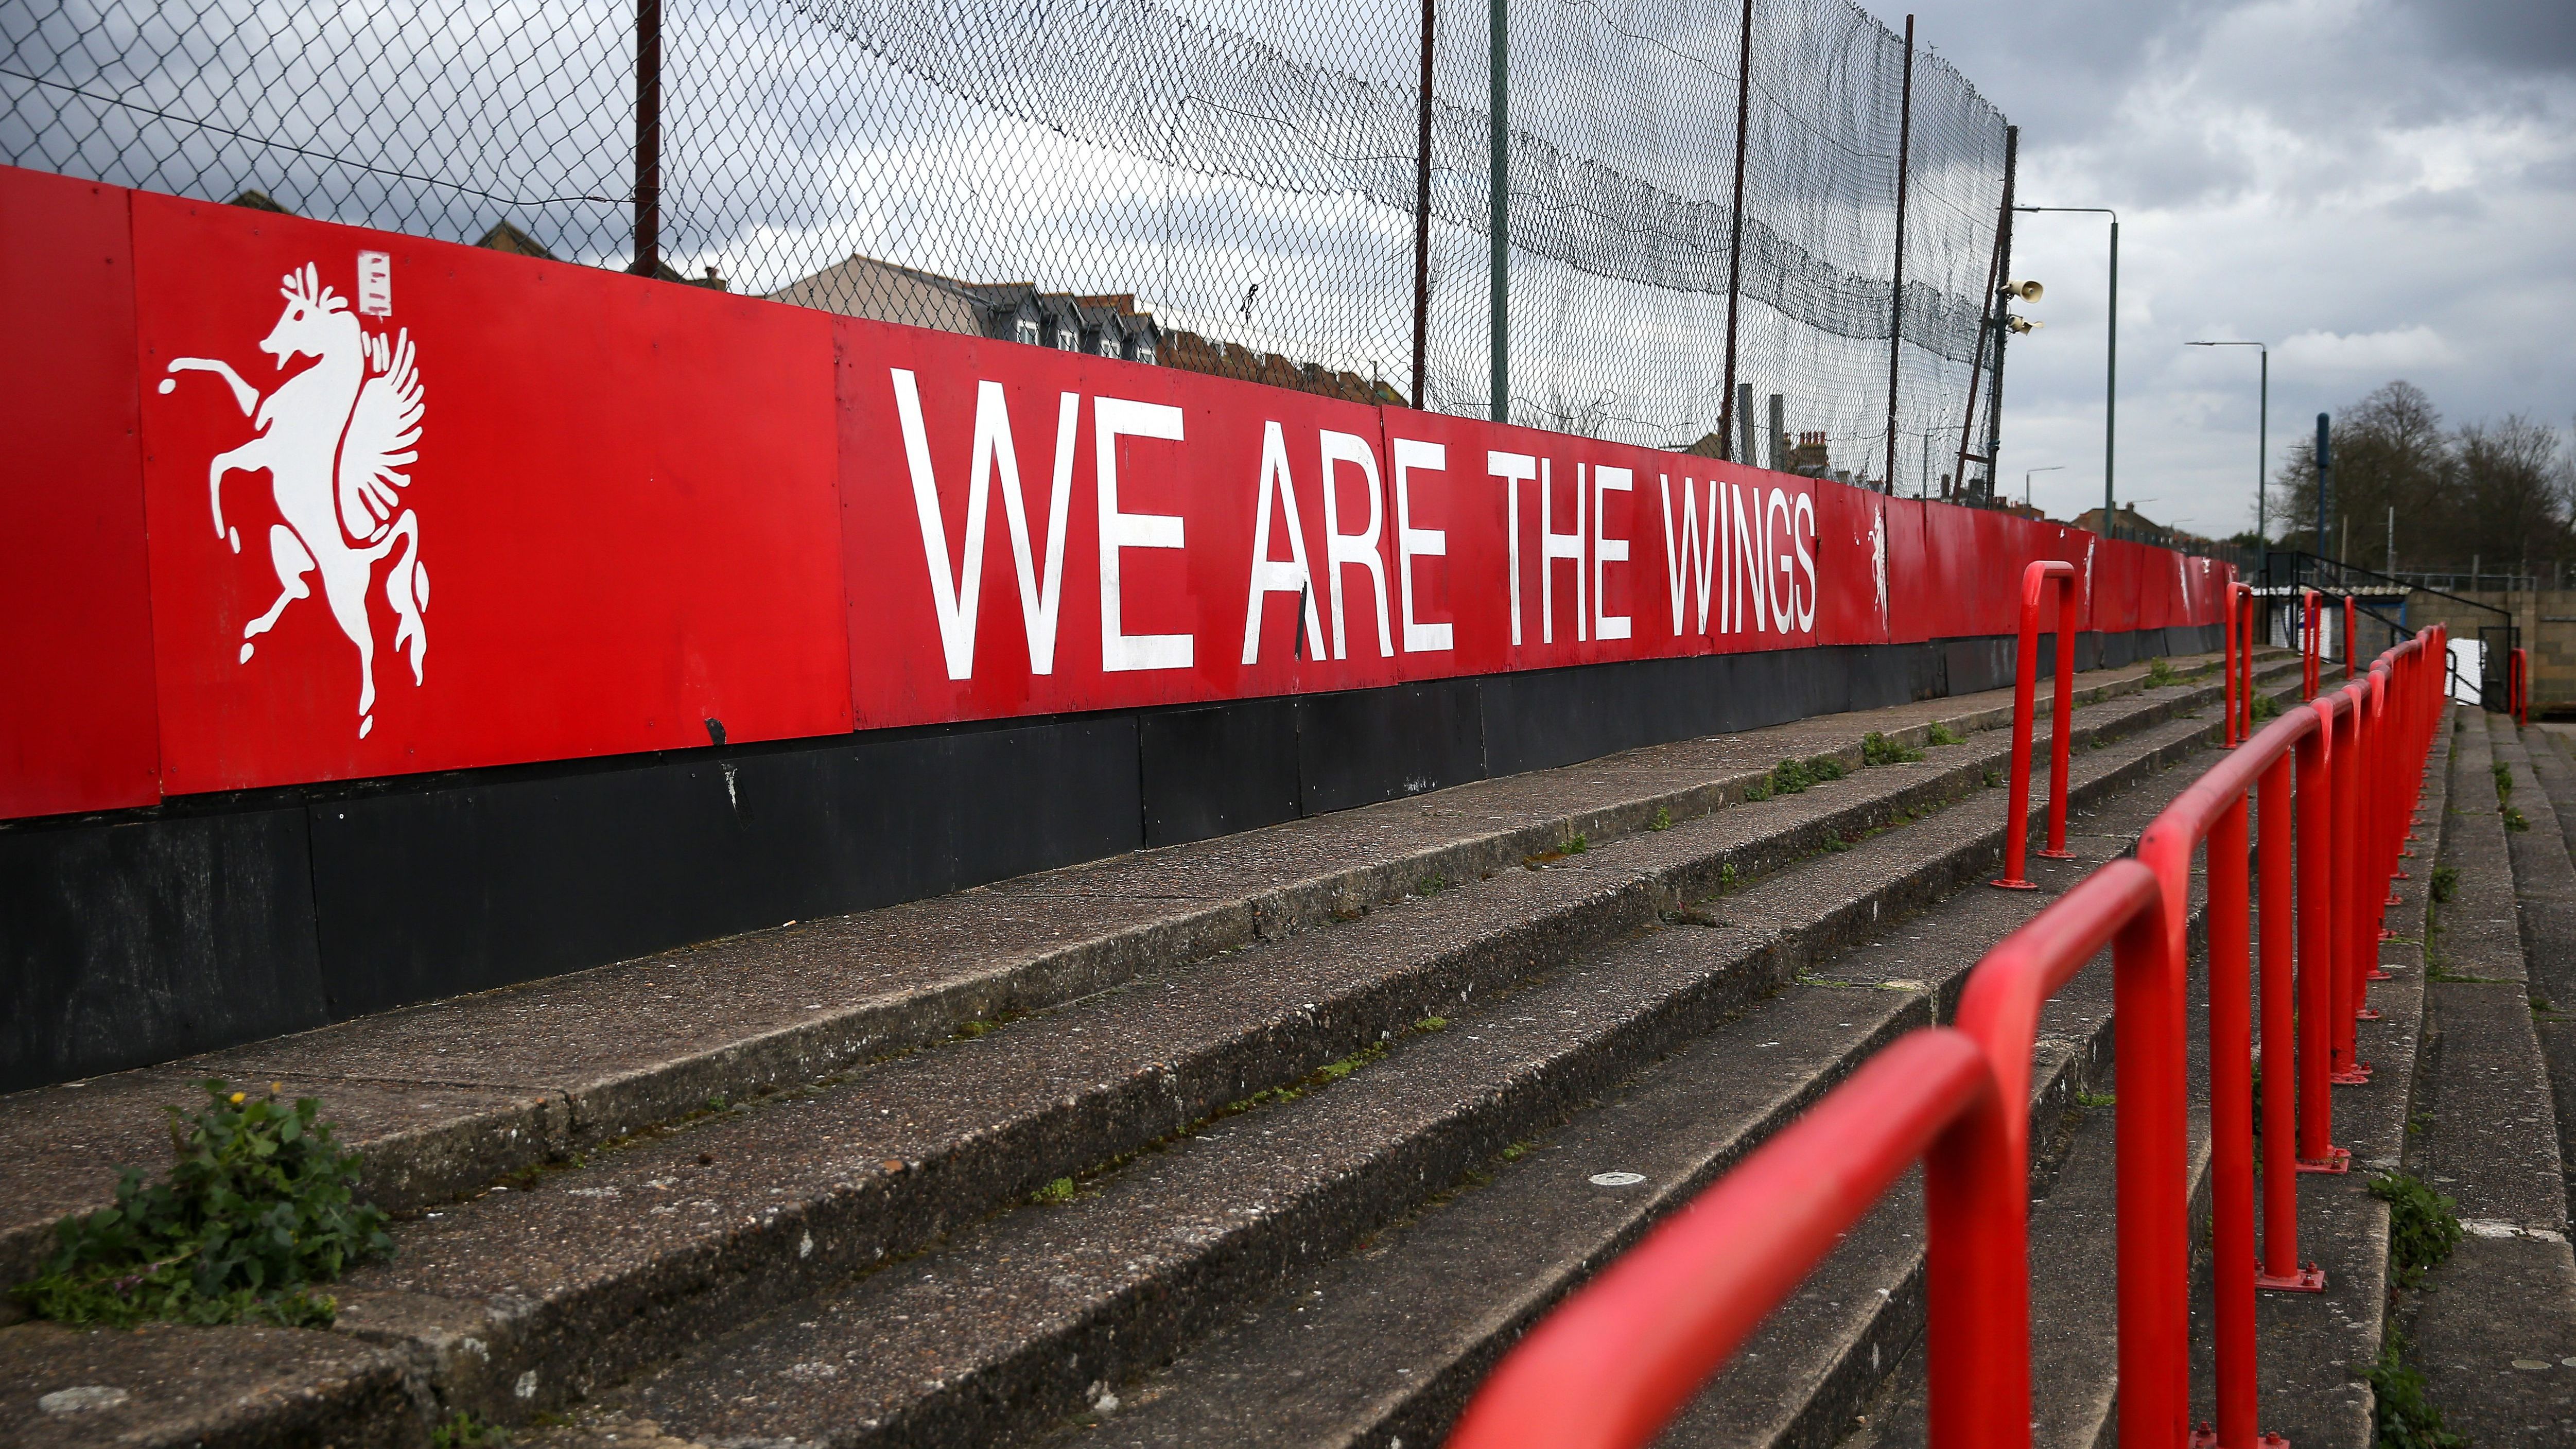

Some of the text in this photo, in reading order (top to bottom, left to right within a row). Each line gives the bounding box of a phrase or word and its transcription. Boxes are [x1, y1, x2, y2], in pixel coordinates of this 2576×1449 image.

[890, 368, 1816, 680] WE ARE THE WINGS
